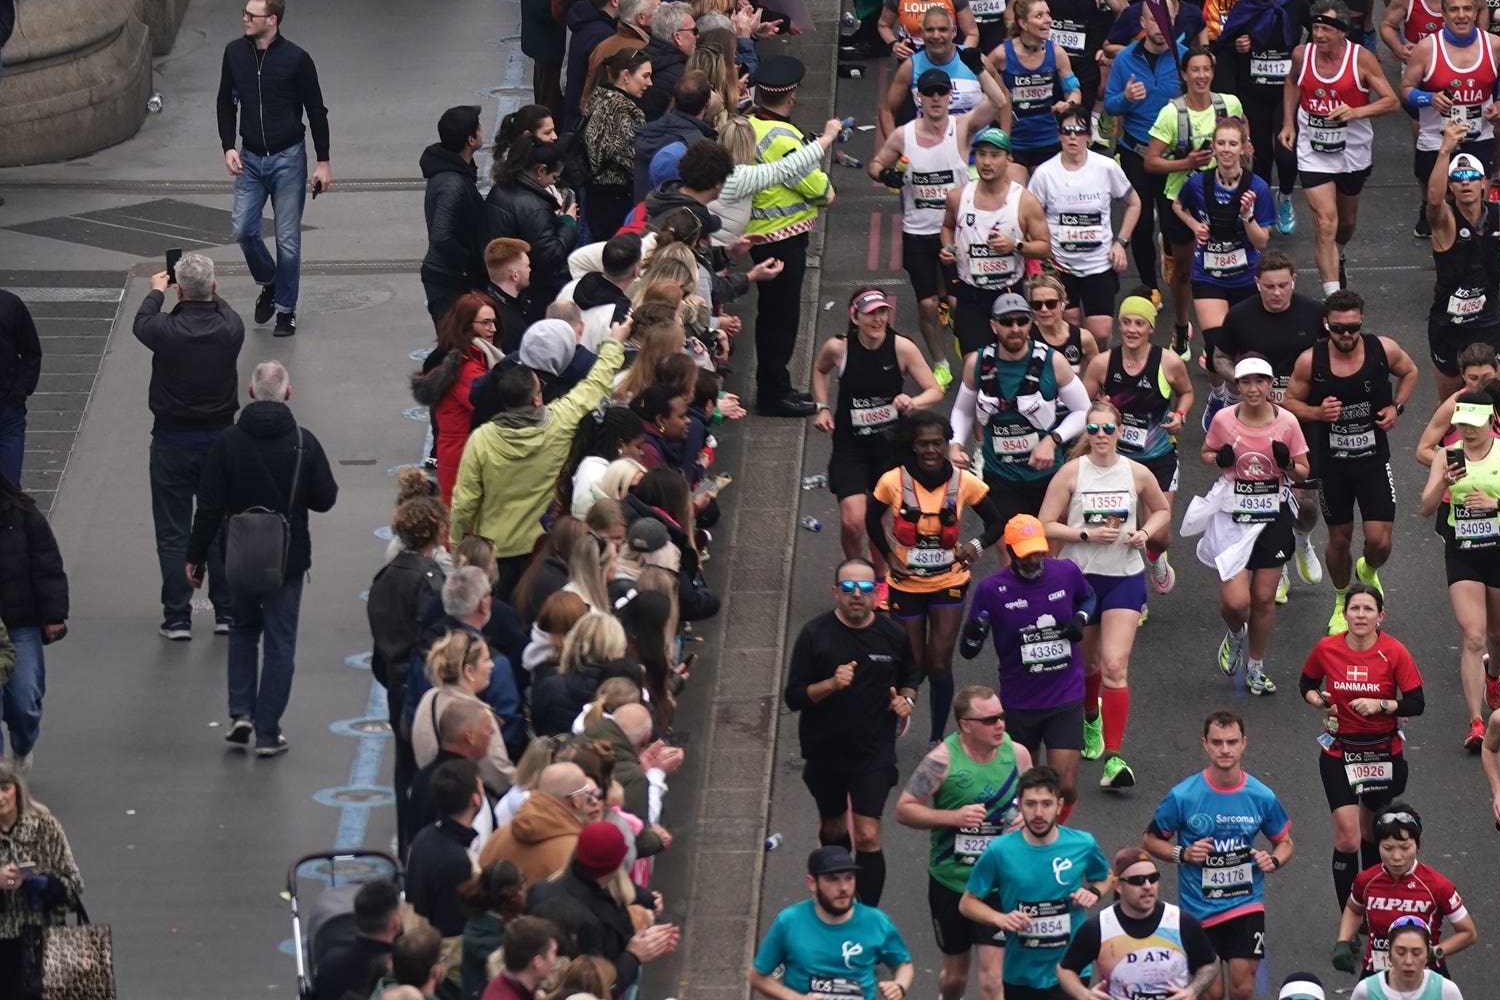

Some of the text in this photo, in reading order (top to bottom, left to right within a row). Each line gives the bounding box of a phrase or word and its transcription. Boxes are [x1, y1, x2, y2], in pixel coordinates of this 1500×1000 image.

[972, 1, 1000, 12] 48244
[1257, 64, 1285, 72] 44112
[1451, 89, 1483, 102] ALIA
[1313, 131, 1342, 141] 46777
[1213, 254, 1237, 265] 7848
[1456, 301, 1484, 312] 14262
[1002, 438, 1029, 450] 9540
[1337, 436, 1369, 446] 54199
[1090, 497, 1123, 508] 13557
[1239, 498, 1272, 509] 49345
[1460, 522, 1492, 534] 54099
[1030, 643, 1064, 658] 43363
[1333, 680, 1380, 693] DANMARK
[1351, 766, 1385, 777] 10926
[1216, 813, 1254, 824] Sarcoma
[1213, 836, 1248, 852] WILL
[1211, 869, 1245, 882] 43176
[1367, 896, 1431, 913] JAPAN
[1126, 951, 1170, 964] DAN
